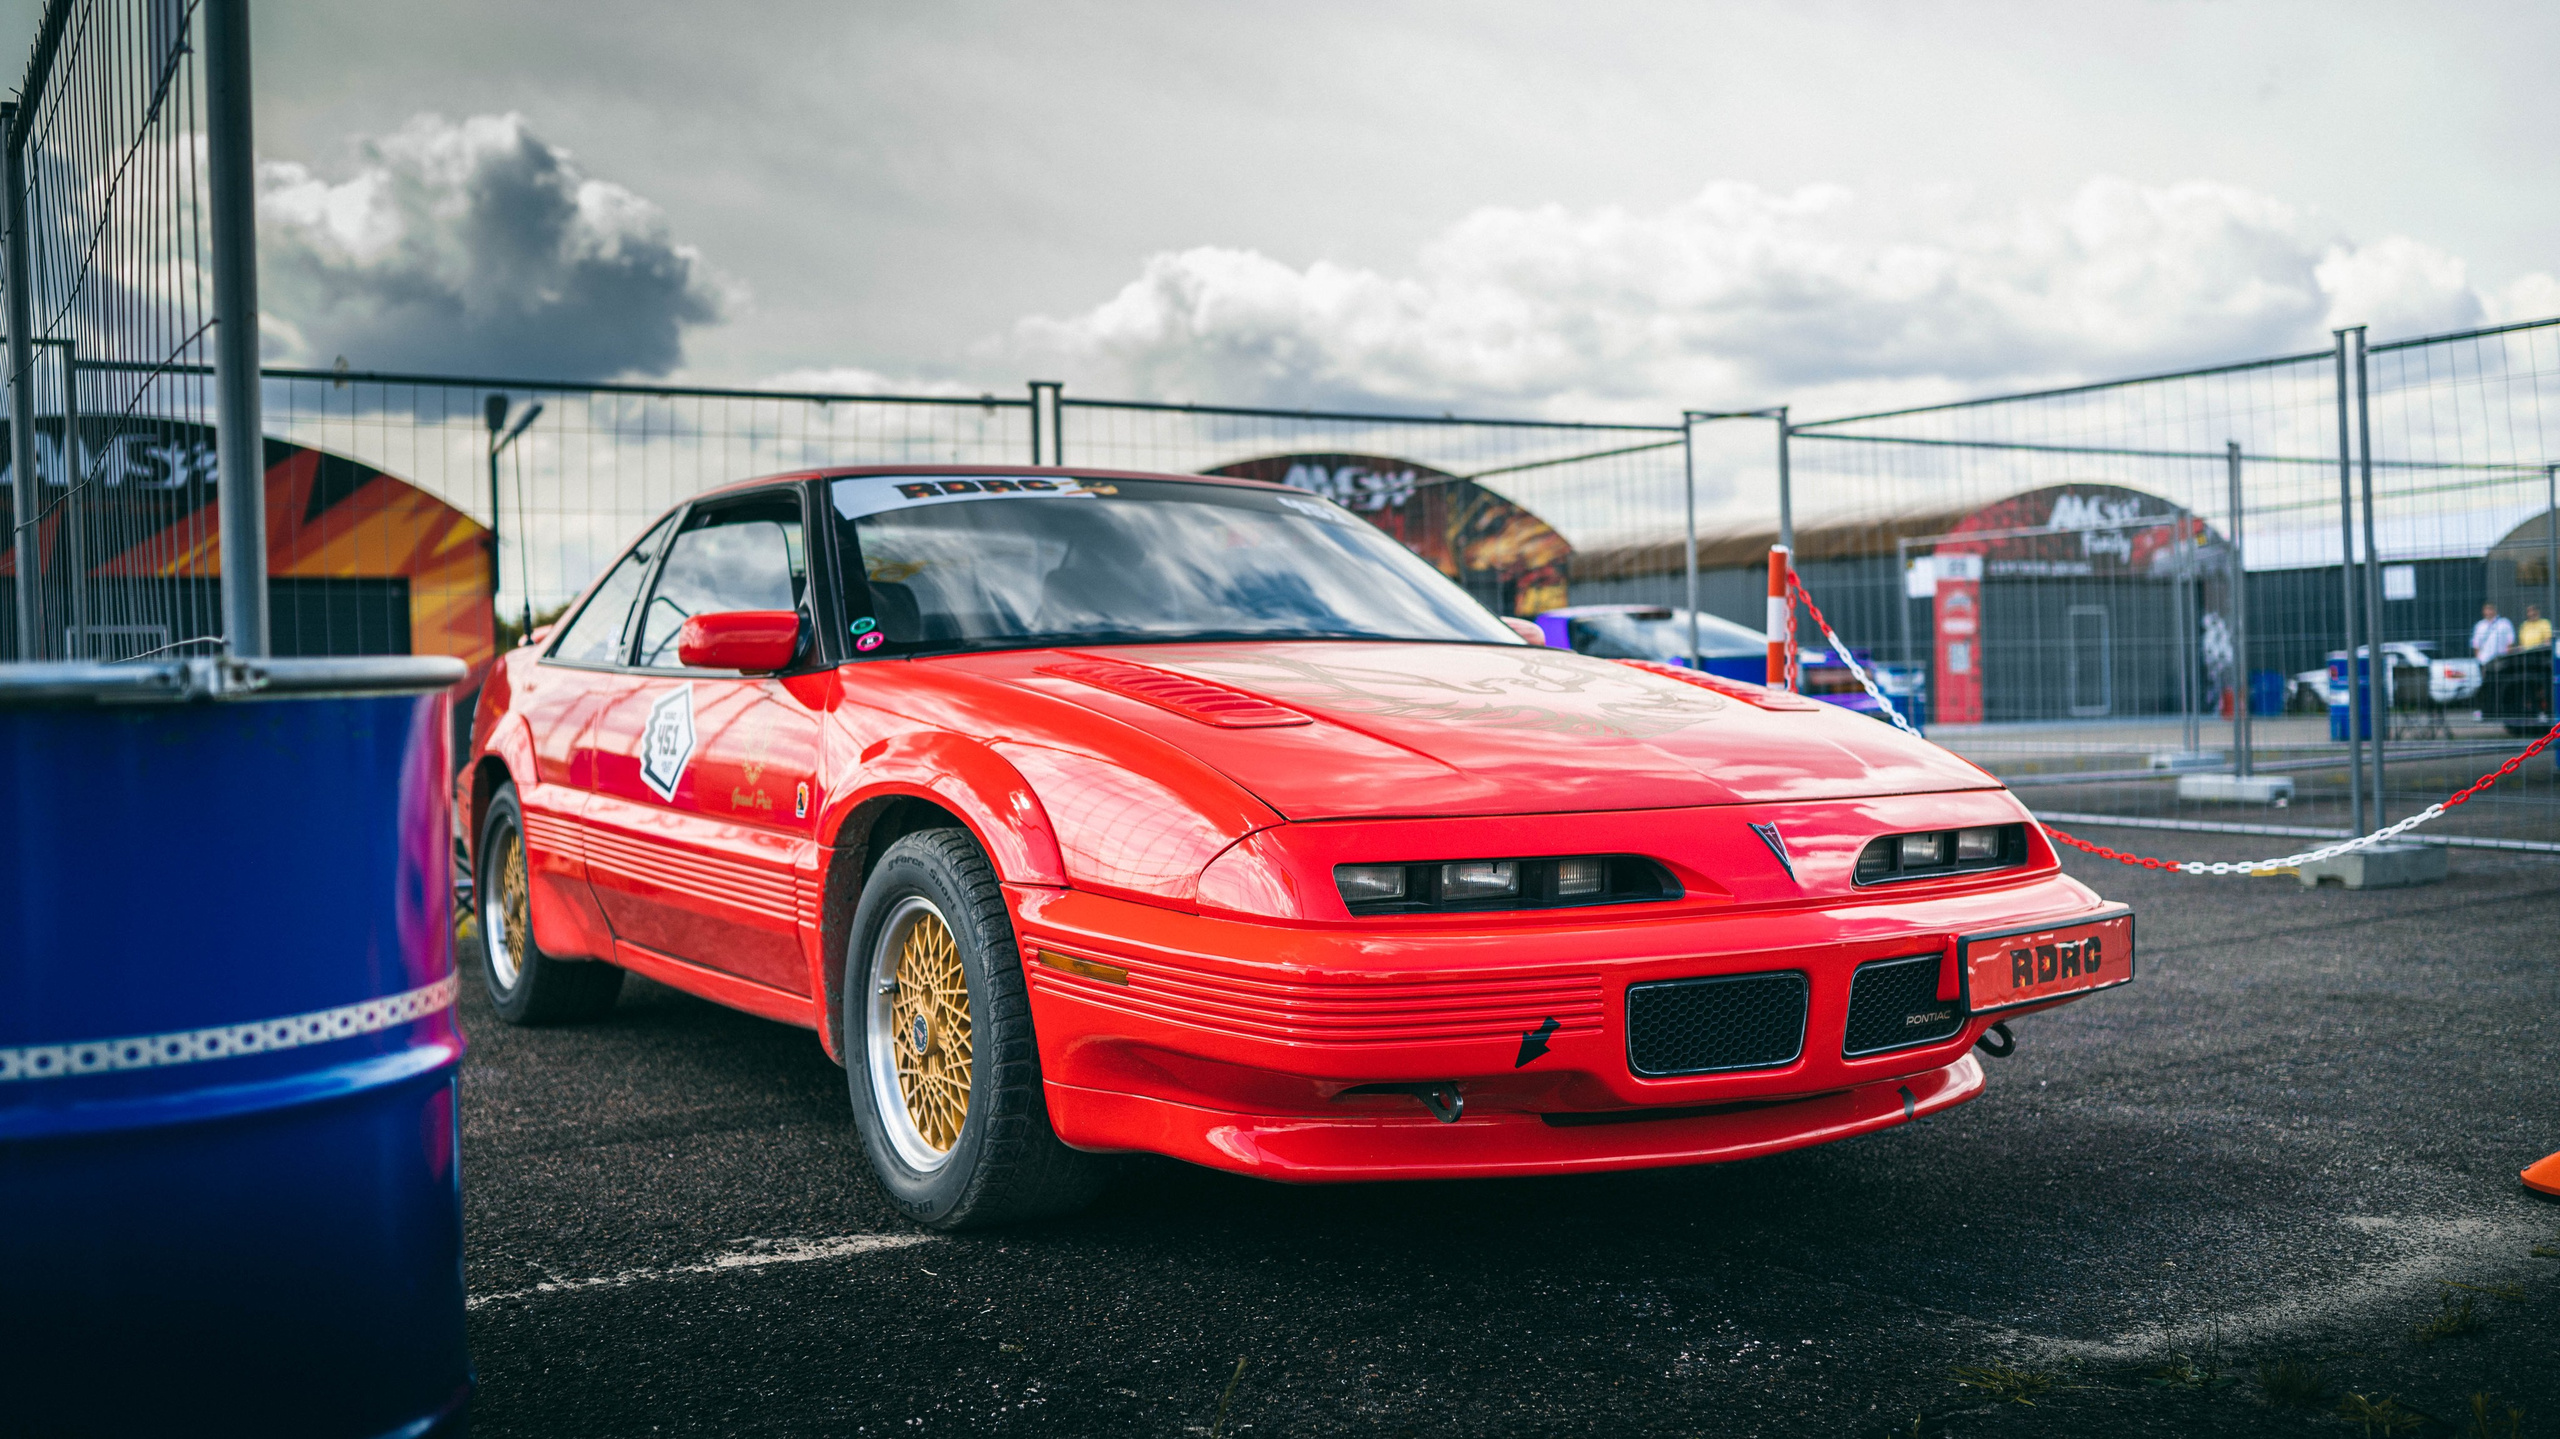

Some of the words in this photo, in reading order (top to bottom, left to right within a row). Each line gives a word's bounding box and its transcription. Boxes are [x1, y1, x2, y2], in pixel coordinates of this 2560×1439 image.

[893, 479, 1060, 500] RDRC
[657, 724, 680, 756] 451
[2010, 936, 2102, 989] RDRC
[1906, 1009, 1951, 1026] PONTIAC
